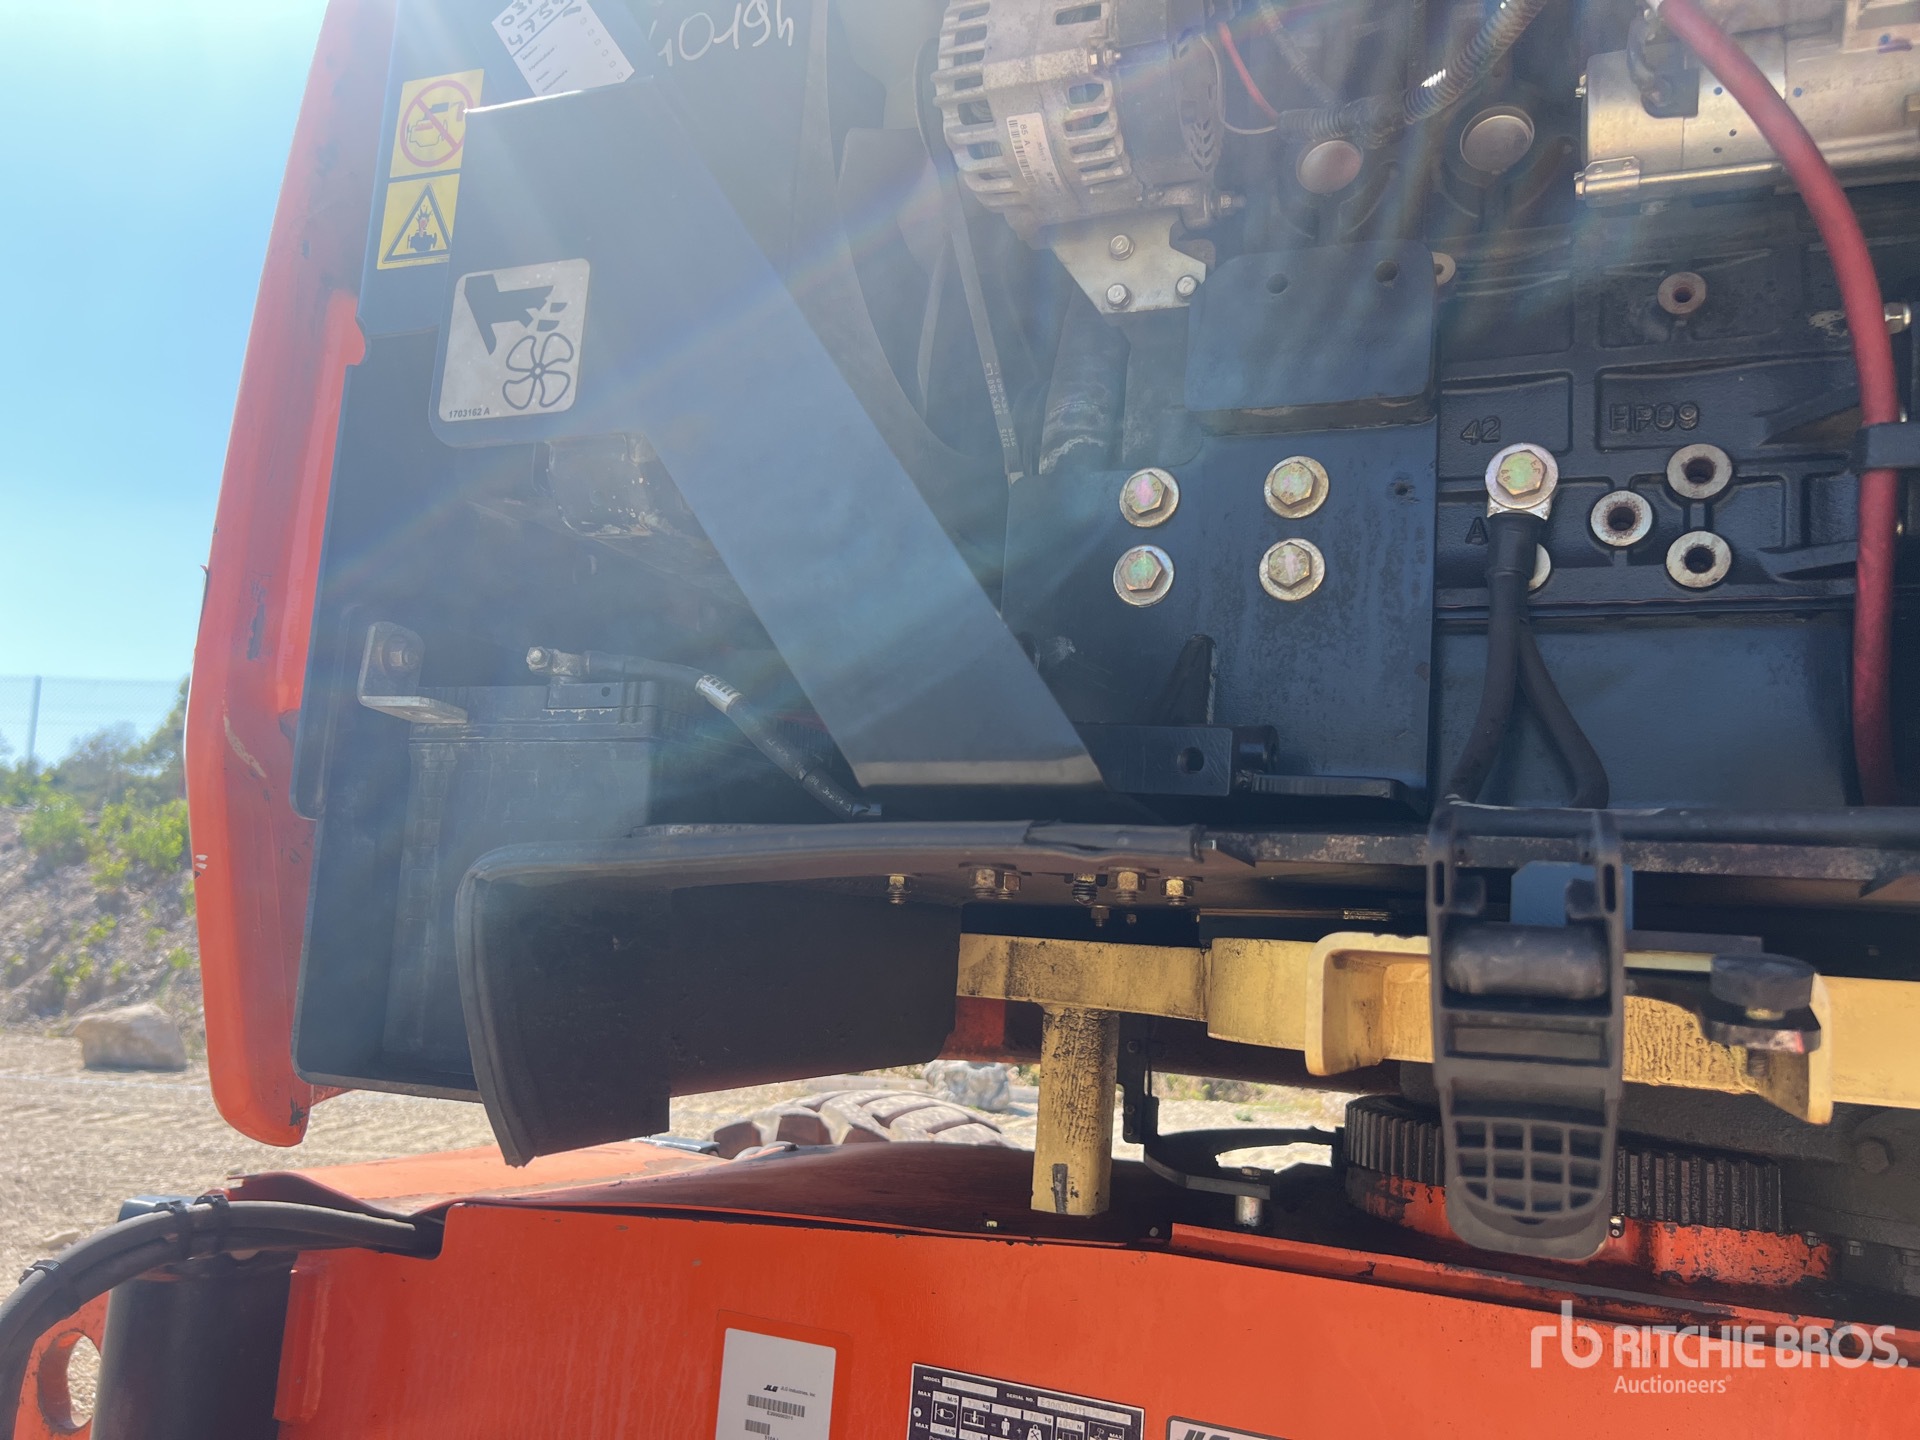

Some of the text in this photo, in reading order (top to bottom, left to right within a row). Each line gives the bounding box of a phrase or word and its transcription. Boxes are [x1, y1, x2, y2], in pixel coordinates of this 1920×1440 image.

[501, 0, 532, 27] 03
[449, 408, 482, 418] 1703162
[1460, 416, 1501, 445] 42
[1465, 516, 1488, 545] A
[923, 1375, 941, 1384] MODEL
[917, 1390, 931, 1398] MAX
[1006, 1393, 1024, 1401] SERIAL
[915, 1422, 929, 1430] MAX
